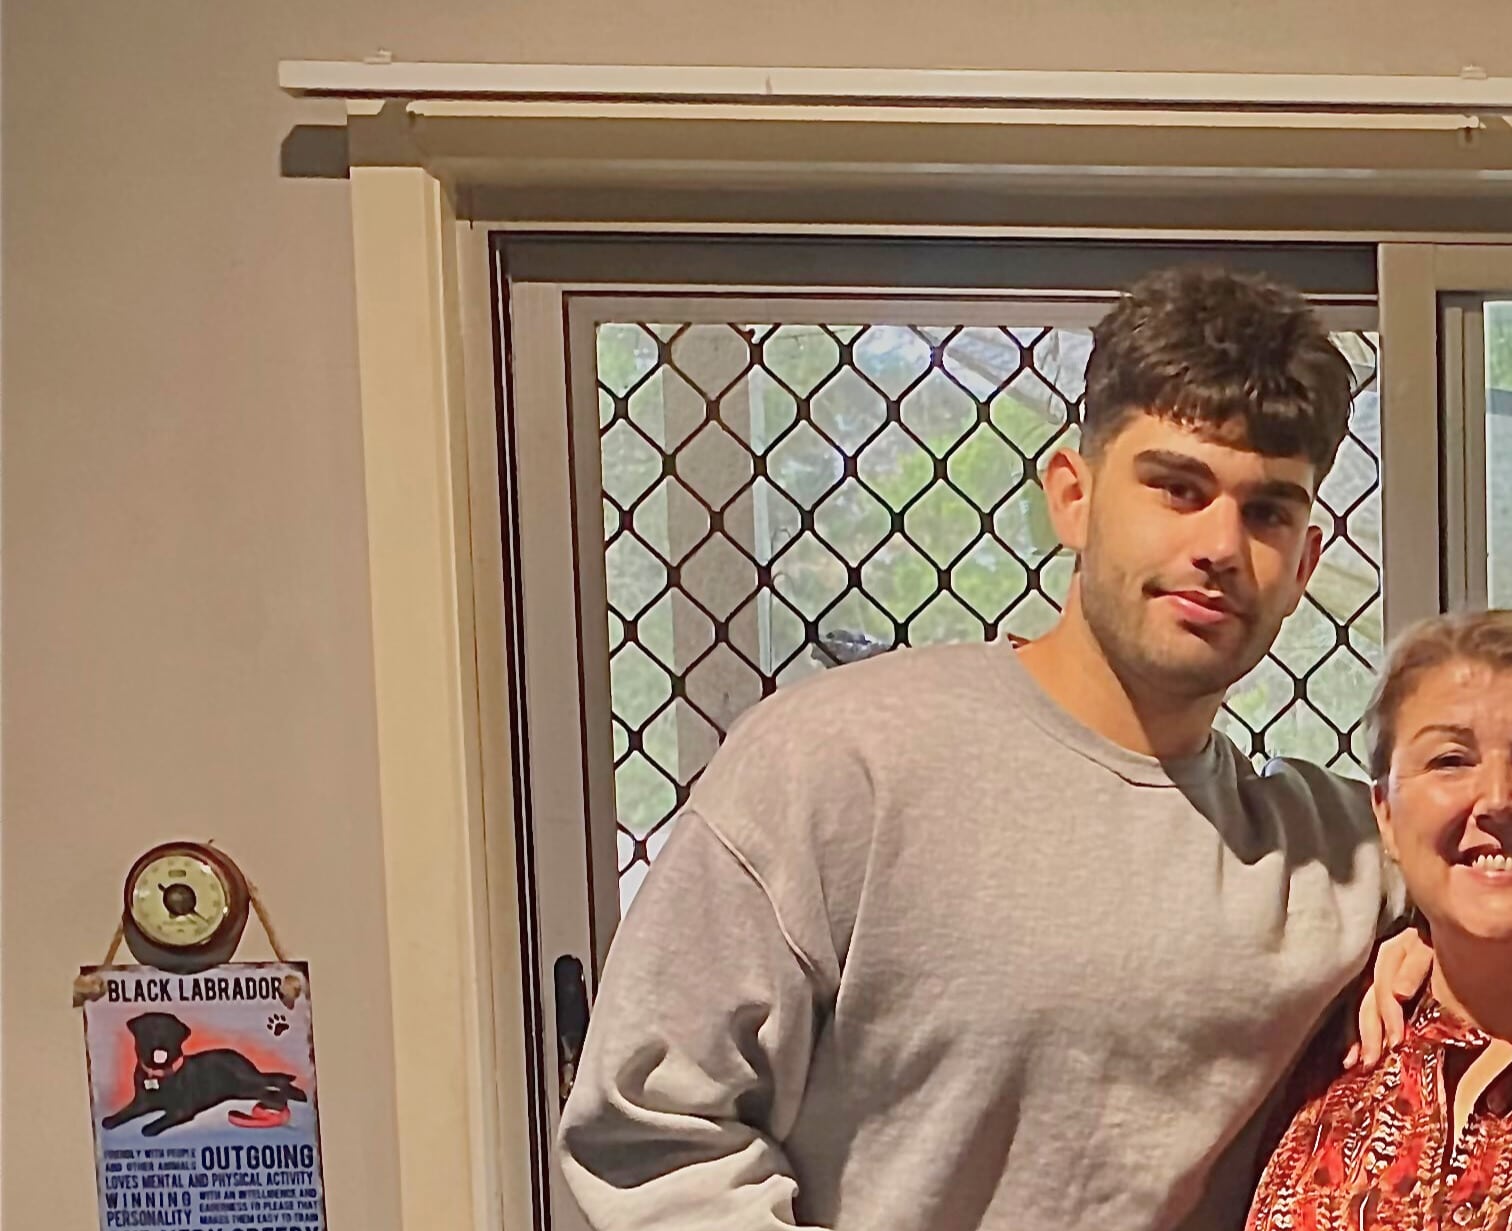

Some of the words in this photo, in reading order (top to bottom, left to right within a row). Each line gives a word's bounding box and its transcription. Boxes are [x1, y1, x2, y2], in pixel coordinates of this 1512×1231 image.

[107, 978, 172, 1002] BLACK
[178, 977, 283, 1001] LABRADOR
[201, 1144, 314, 1170] OUTGOING
[105, 1174, 139, 1189] LOVES
[142, 1173, 184, 1188] MENTAL
[188, 1173, 208, 1188] AND
[211, 1172, 262, 1187] PHYSICAL
[267, 1171, 313, 1186] ACTIVITY
[105, 1191, 191, 1209] WINNING
[107, 1209, 192, 1227] PERSONALITY
